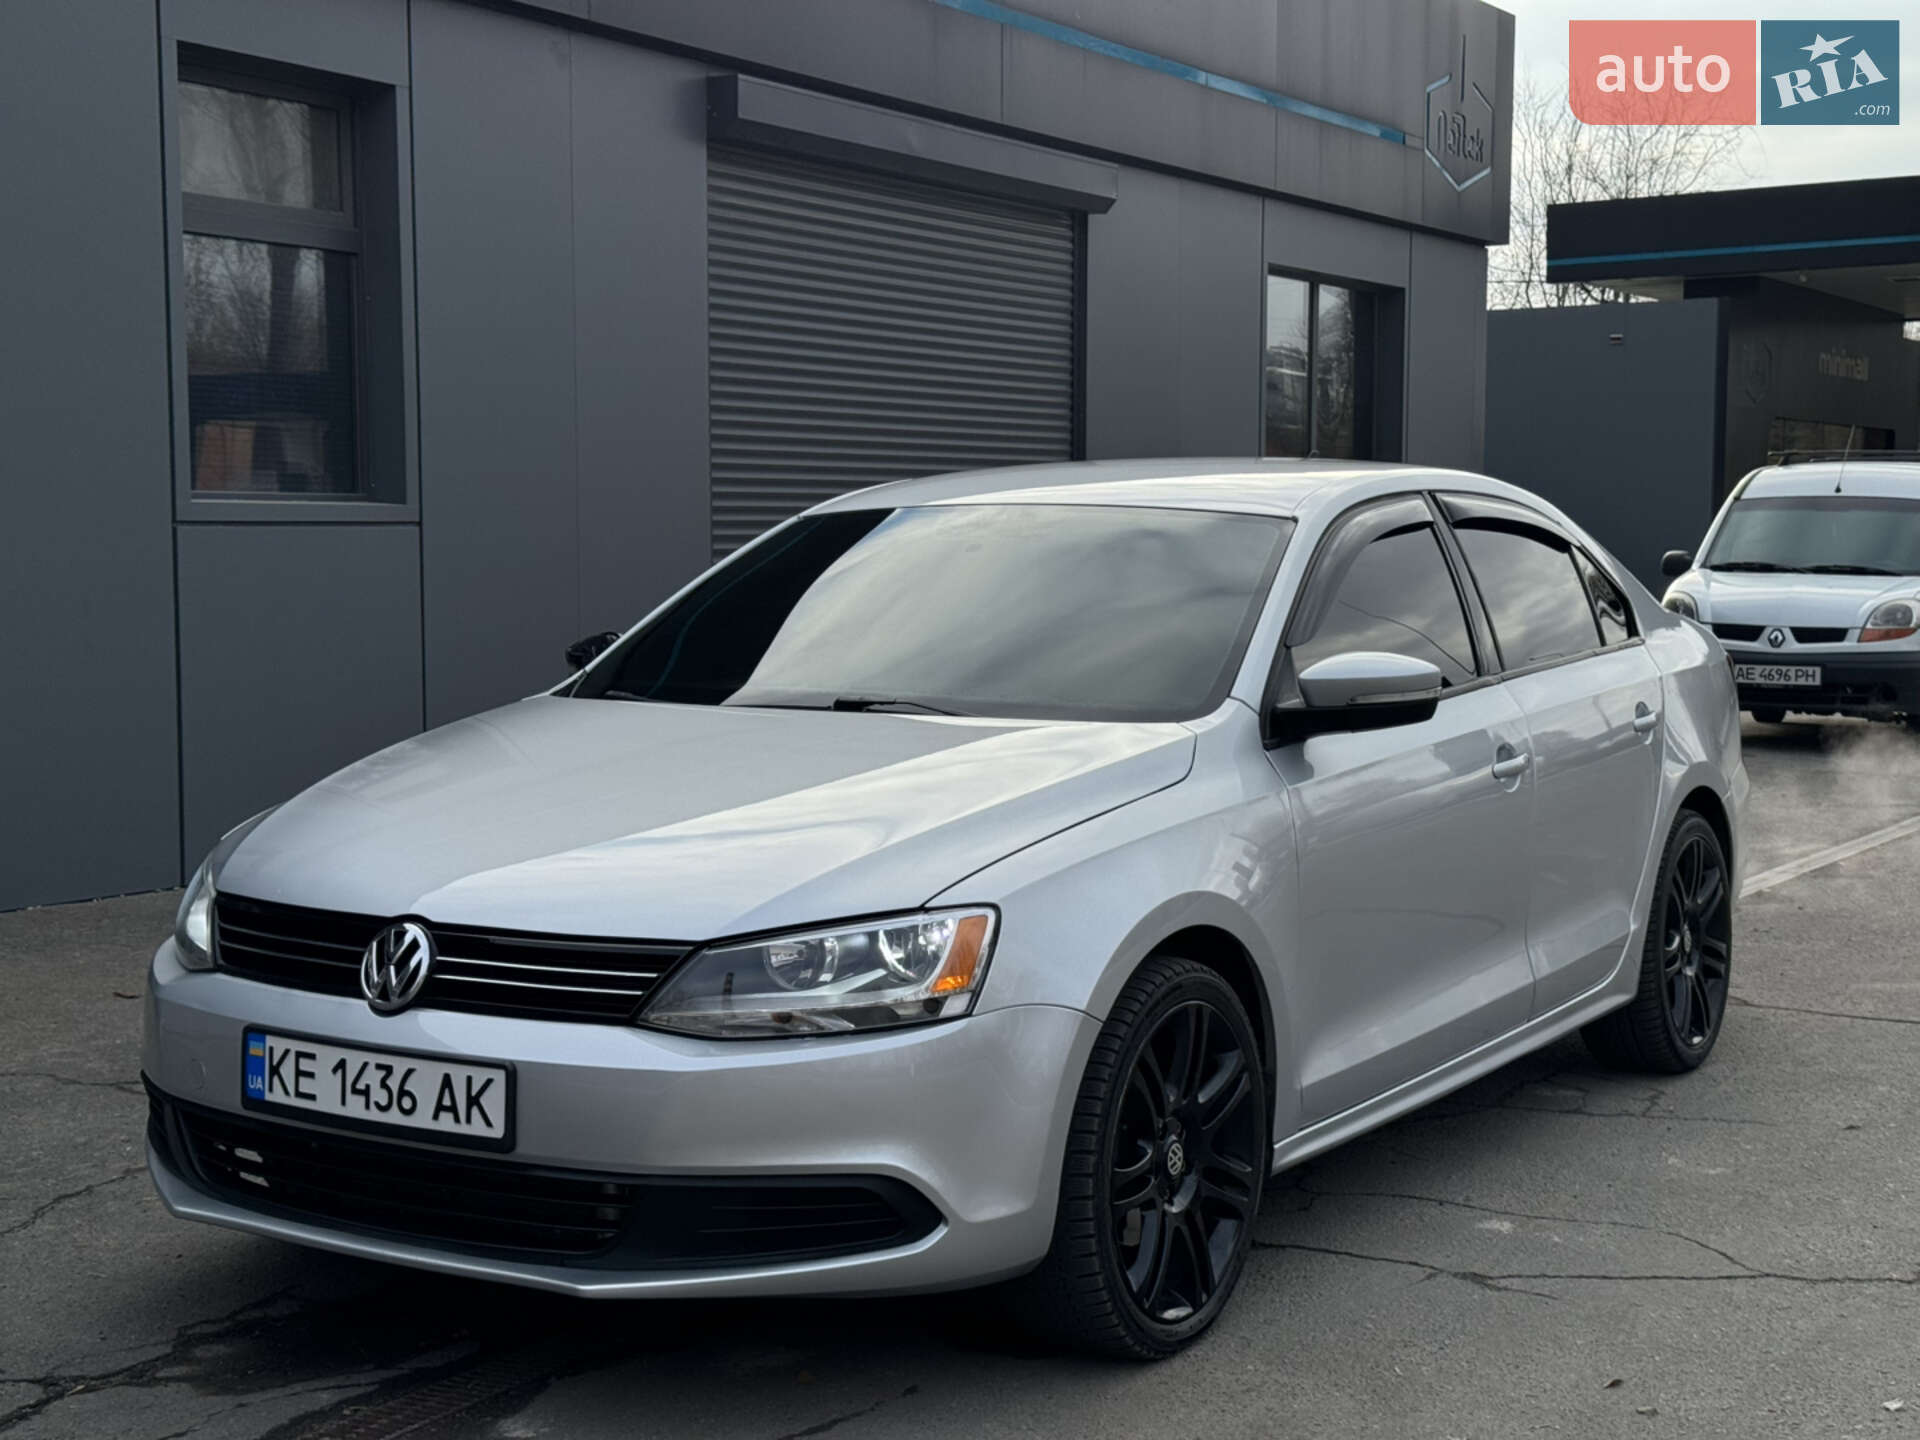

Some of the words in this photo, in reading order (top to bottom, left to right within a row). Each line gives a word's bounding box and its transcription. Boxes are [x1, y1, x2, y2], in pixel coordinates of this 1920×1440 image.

[1736, 667, 1756, 681] AE
[1759, 668, 1792, 682] 4696
[1795, 669, 1816, 683] PH
[248, 1074, 264, 1091] UA
[268, 1045, 318, 1102] KE
[331, 1057, 418, 1117] 1436
[431, 1072, 495, 1129] AK
